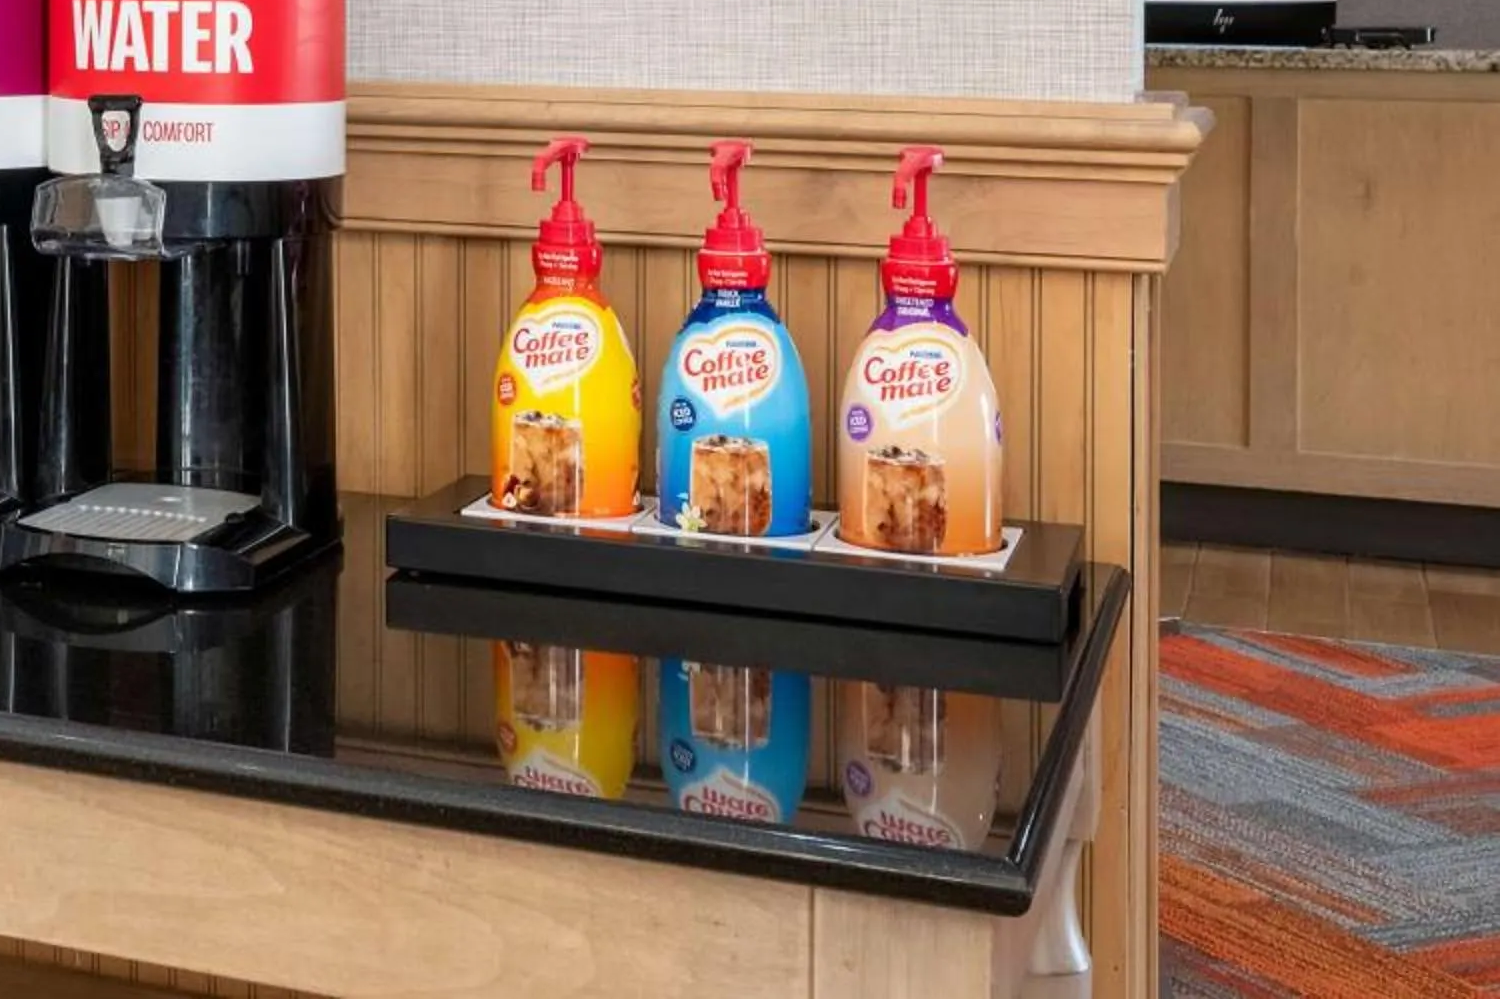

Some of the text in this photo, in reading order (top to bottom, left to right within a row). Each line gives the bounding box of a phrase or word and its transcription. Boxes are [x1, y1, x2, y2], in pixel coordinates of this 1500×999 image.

[1213, 8, 1235, 34] hp
[143, 120, 214, 142] COMFORT
[513, 328, 589, 355] Coffee
[525, 346, 590, 369] mate
[683, 348, 766, 377] Coffee
[863, 356, 950, 385] Coffee
[703, 364, 769, 392] mate
[880, 376, 951, 402] mate
